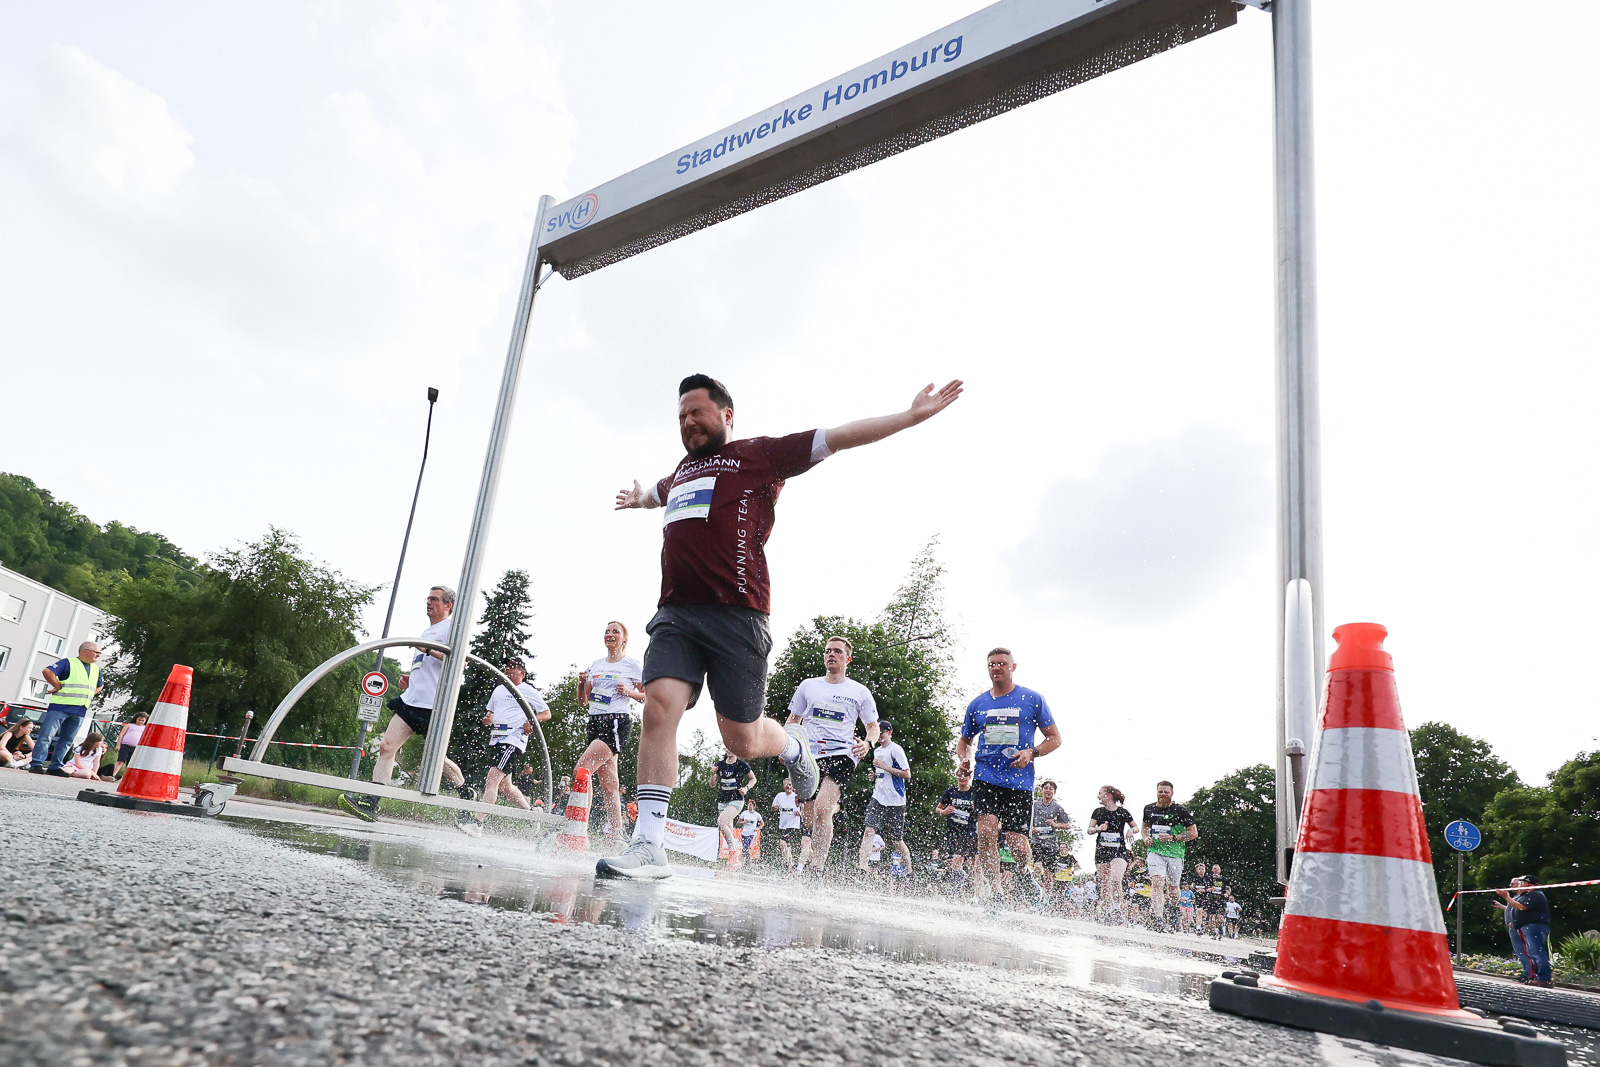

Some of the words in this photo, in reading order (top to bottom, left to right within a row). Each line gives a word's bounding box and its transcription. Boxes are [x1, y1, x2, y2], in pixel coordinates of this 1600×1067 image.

[675, 103, 813, 175] Stadtwerke
[821, 34, 964, 113] Homburg
[675, 493, 696, 503] Julian
[736, 528, 748, 594] RUNNING
